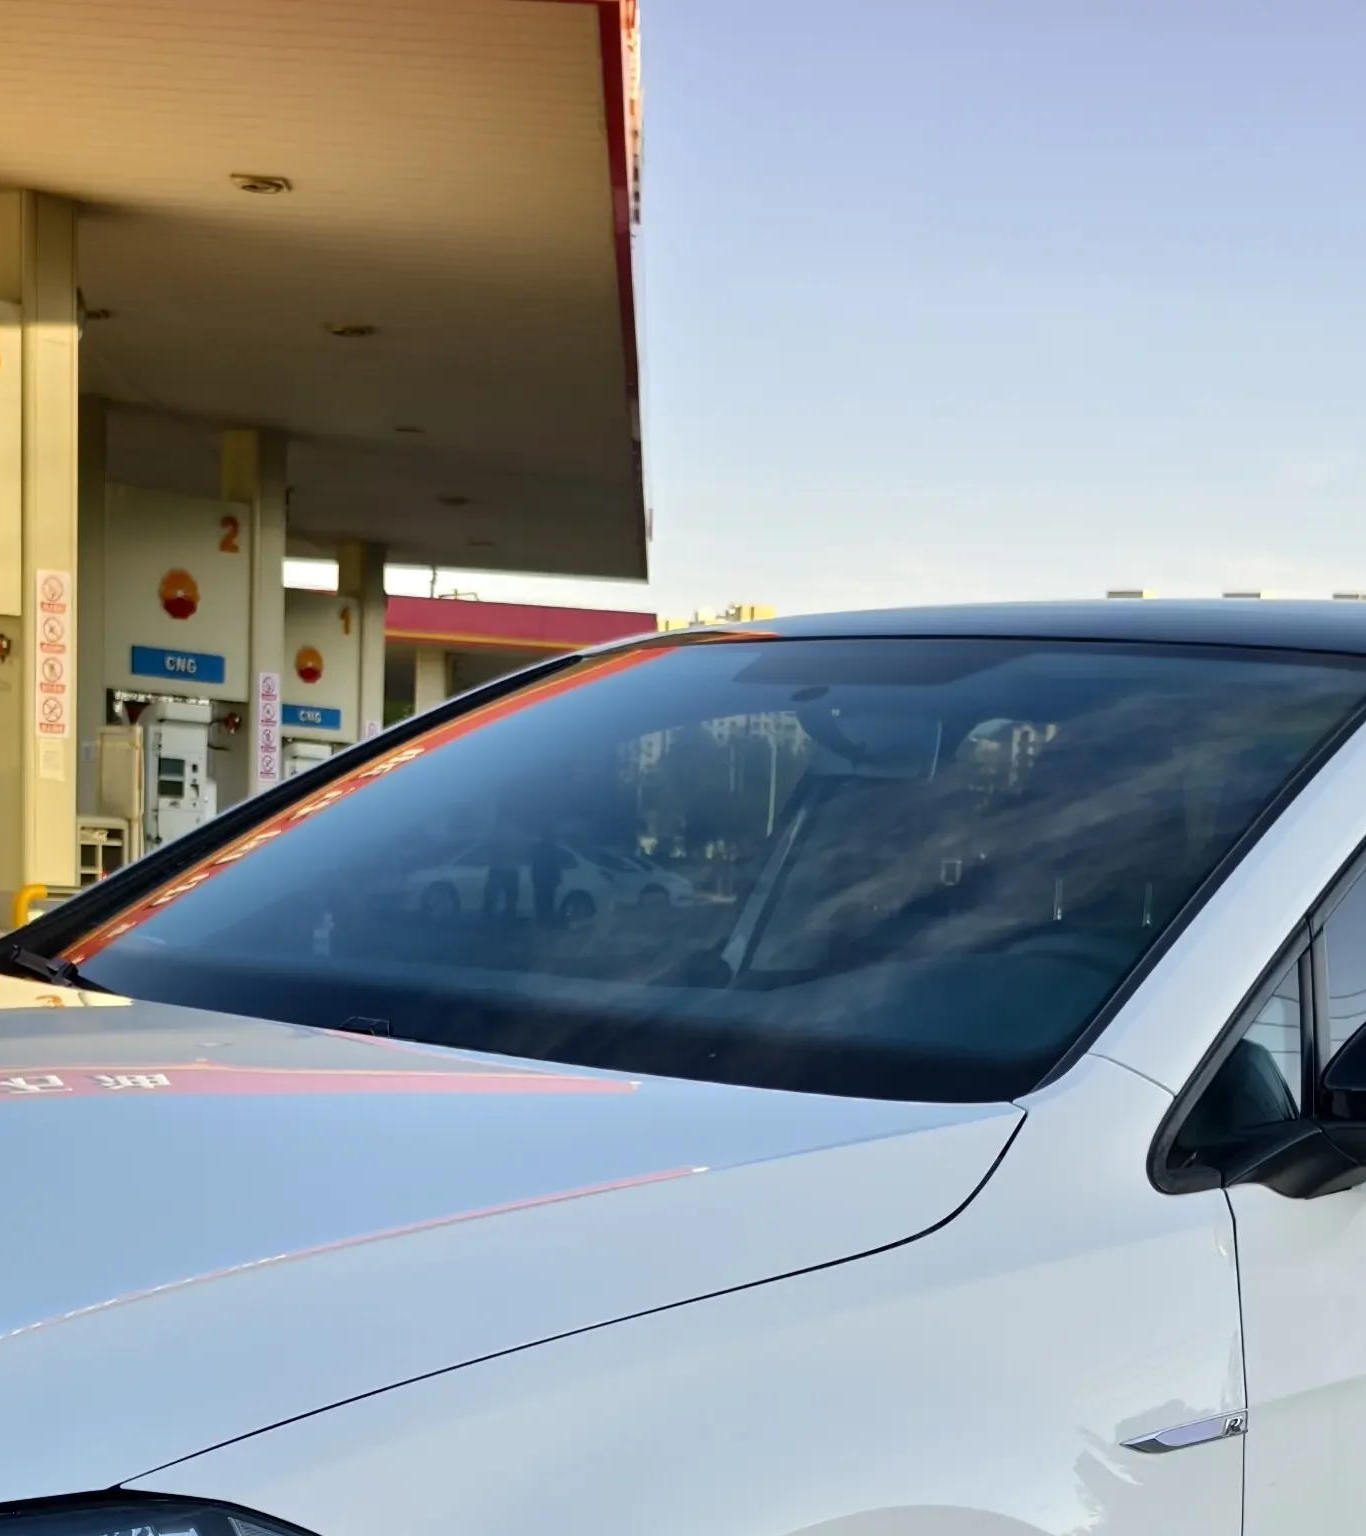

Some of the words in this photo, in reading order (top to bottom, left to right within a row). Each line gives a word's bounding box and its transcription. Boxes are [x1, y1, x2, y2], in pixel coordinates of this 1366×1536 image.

[219, 515, 240, 553] 2
[339, 605, 351, 635] 1
[164, 656, 197, 674] CNG
[298, 709, 322, 724] CNG
